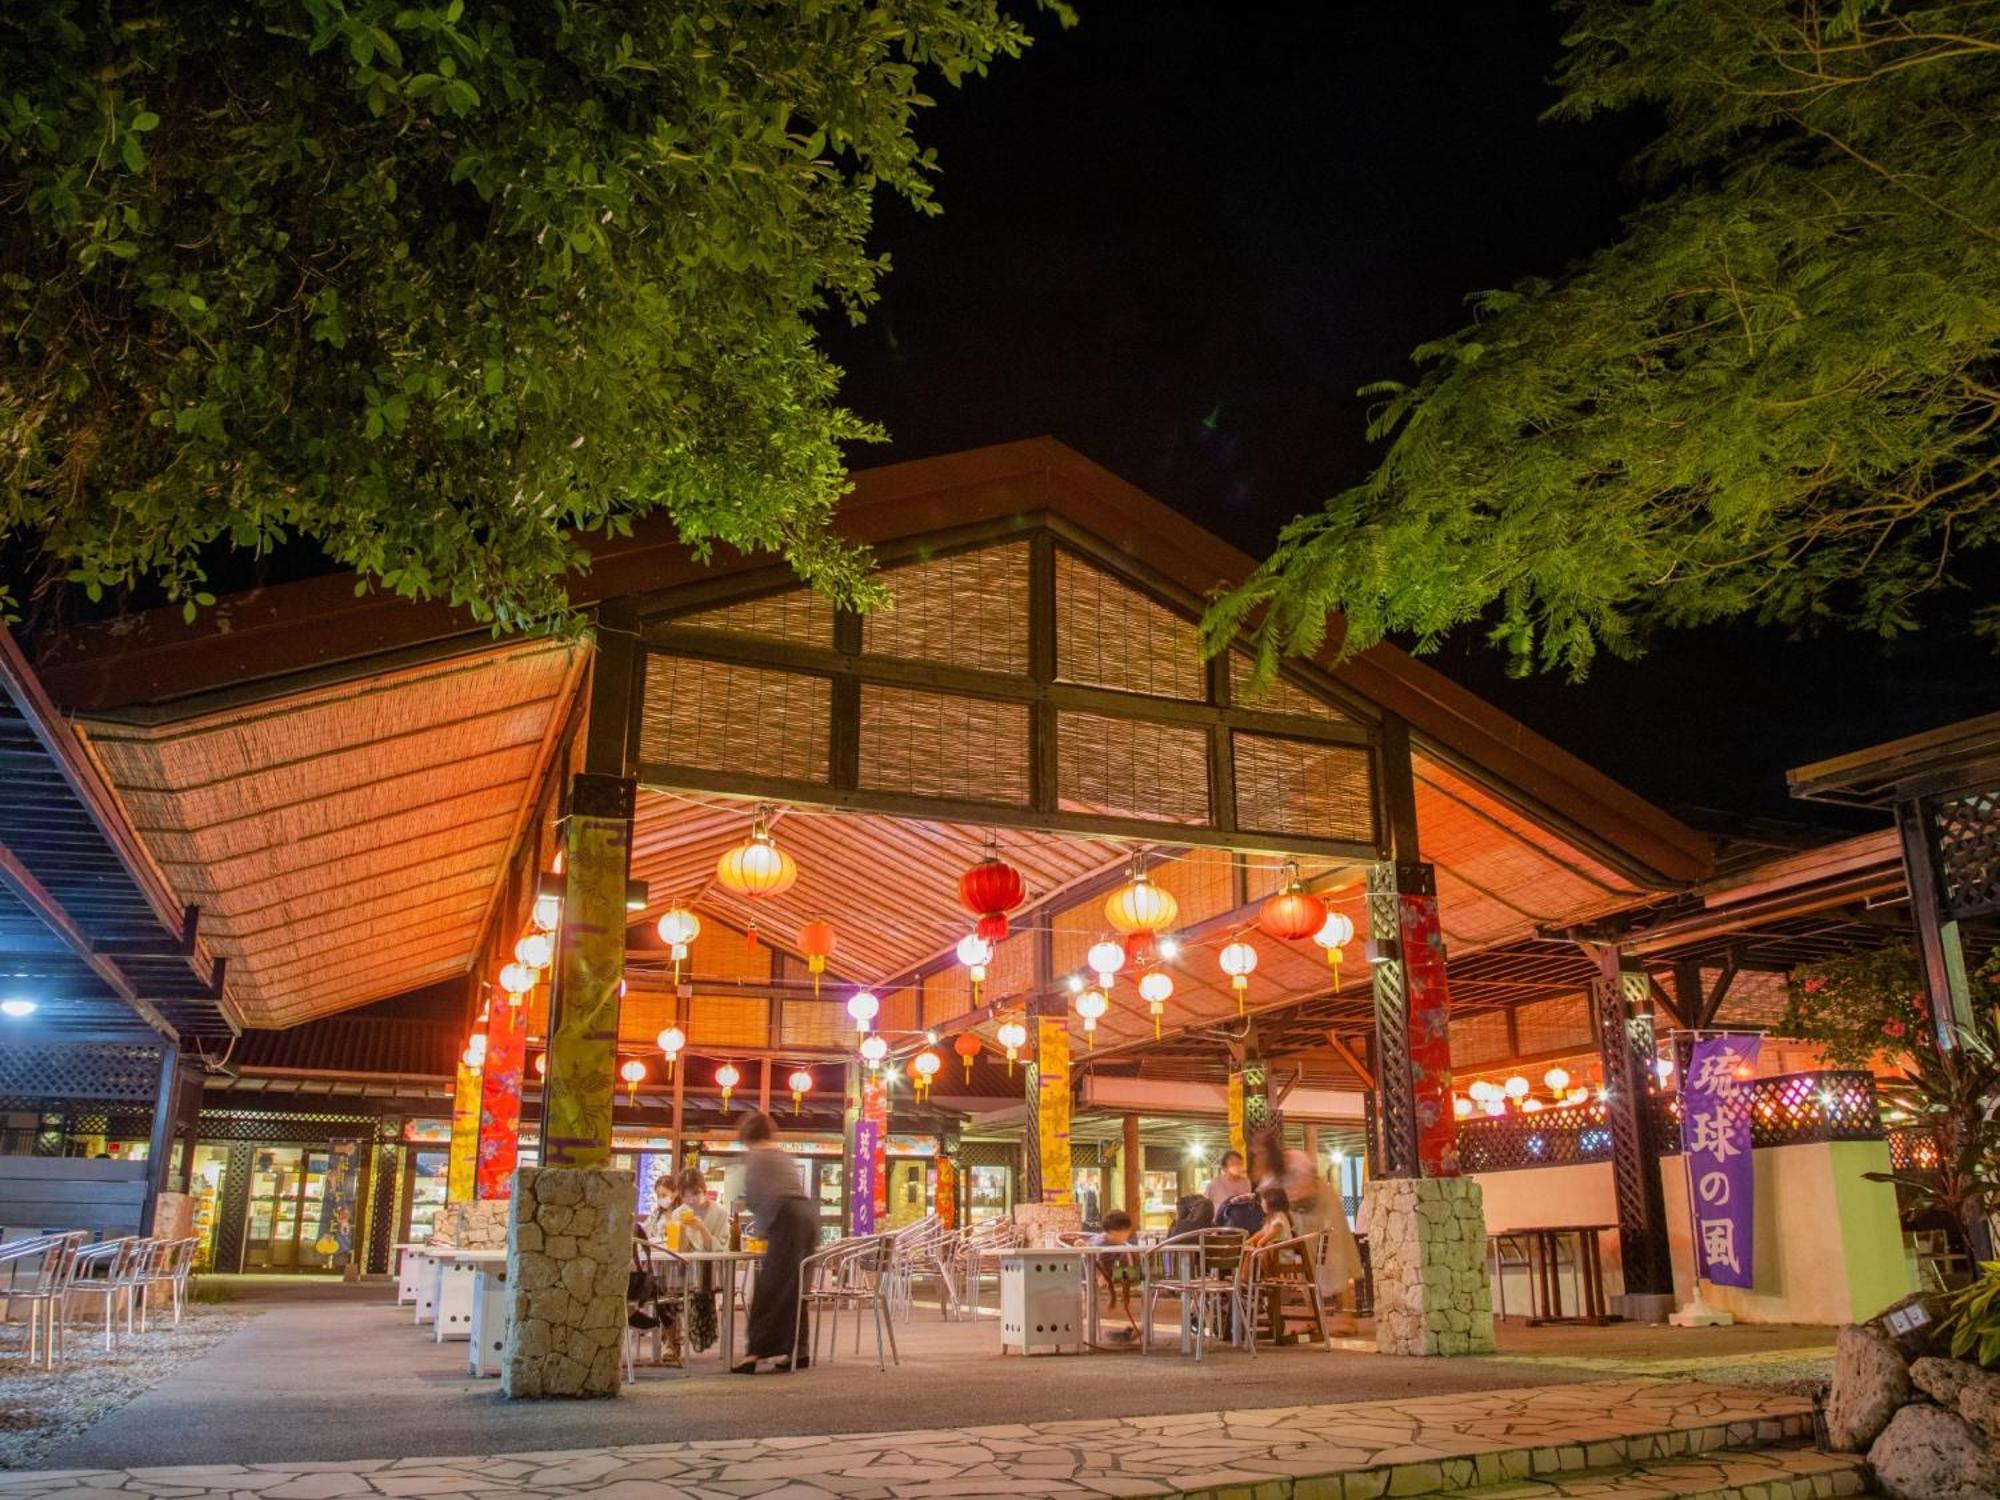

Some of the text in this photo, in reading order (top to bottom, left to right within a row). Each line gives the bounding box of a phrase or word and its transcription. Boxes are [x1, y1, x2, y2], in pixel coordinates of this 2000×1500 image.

[858, 1129, 870, 1236] 琉球の
[1692, 1048, 1741, 1274] 琉球の風
